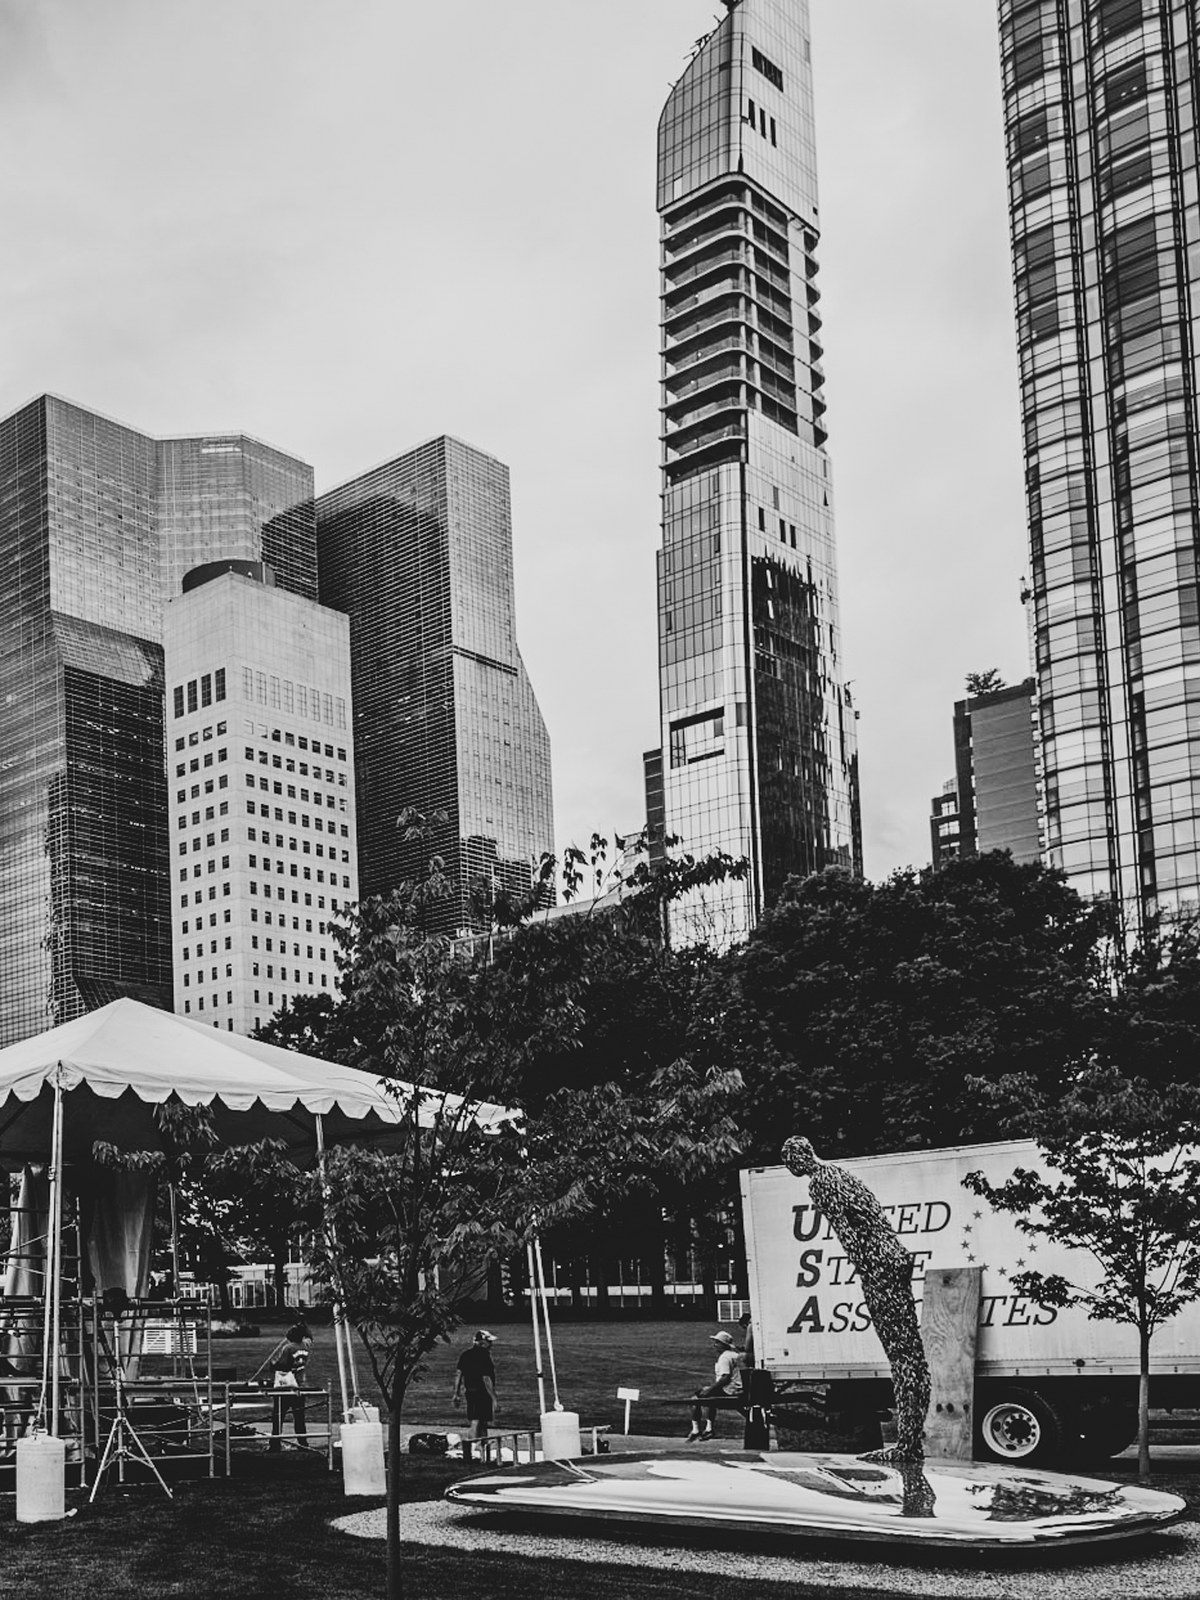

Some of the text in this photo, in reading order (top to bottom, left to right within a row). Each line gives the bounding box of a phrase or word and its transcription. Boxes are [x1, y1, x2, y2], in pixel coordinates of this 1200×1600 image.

[792, 1201, 951, 1242] UED
[796, 1249, 933, 1287] STE
[787, 1295, 1058, 1333] ASSTES
